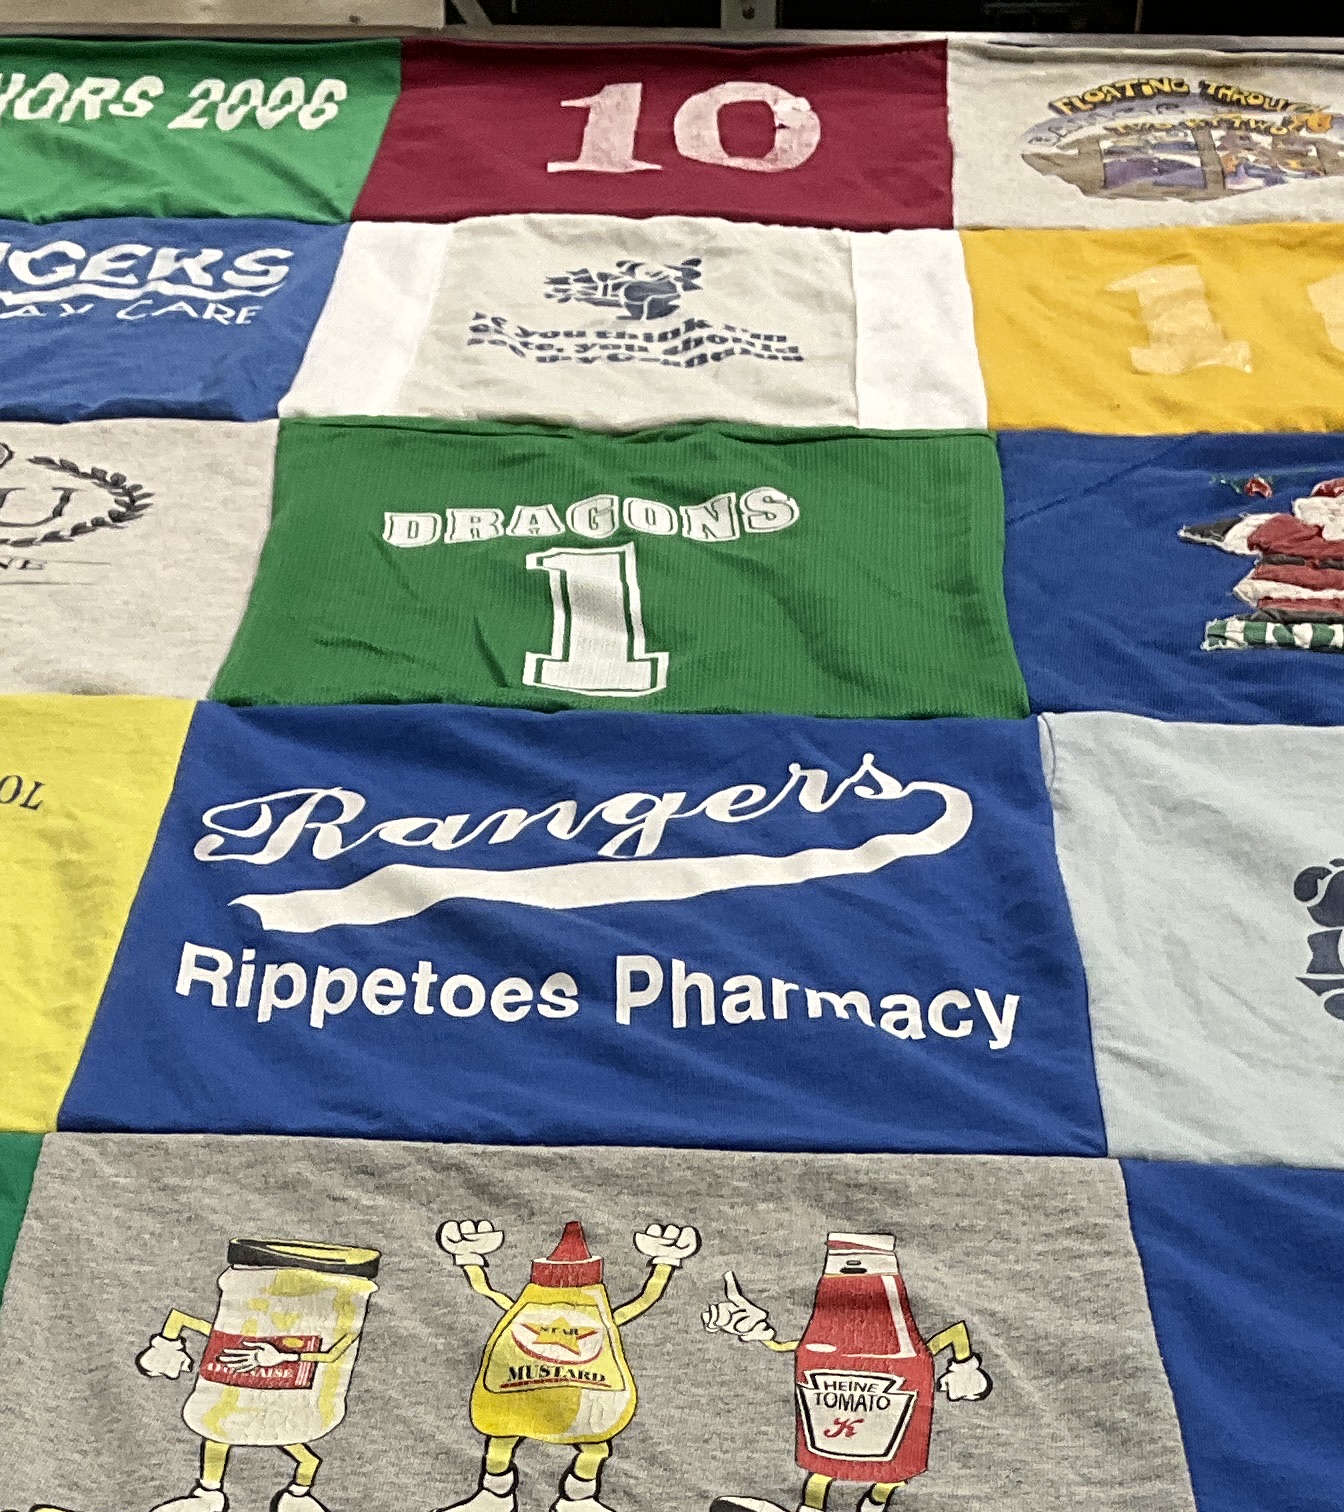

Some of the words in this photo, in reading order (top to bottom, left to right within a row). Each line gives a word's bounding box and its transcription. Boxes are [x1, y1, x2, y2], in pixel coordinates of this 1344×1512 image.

[167, 76, 348, 131] 2006
[1048, 76, 1191, 116] FLOATING
[1198, 80, 1328, 114] THROU
[547, 80, 822, 173] 10
[115, 299, 263, 326] CARE
[382, 486, 800, 547] DRAGONS
[522, 541, 668, 697] 1
[194, 753, 906, 864] Rangers
[174, 940, 580, 1028] Rippetoes
[615, 954, 1020, 1049] Pharmacy
[539, 1325, 580, 1336] STAR
[507, 1364, 606, 1382] MUSTARD
[823, 1380, 879, 1394] HEINE
[814, 1391, 891, 1413] TOMATO
